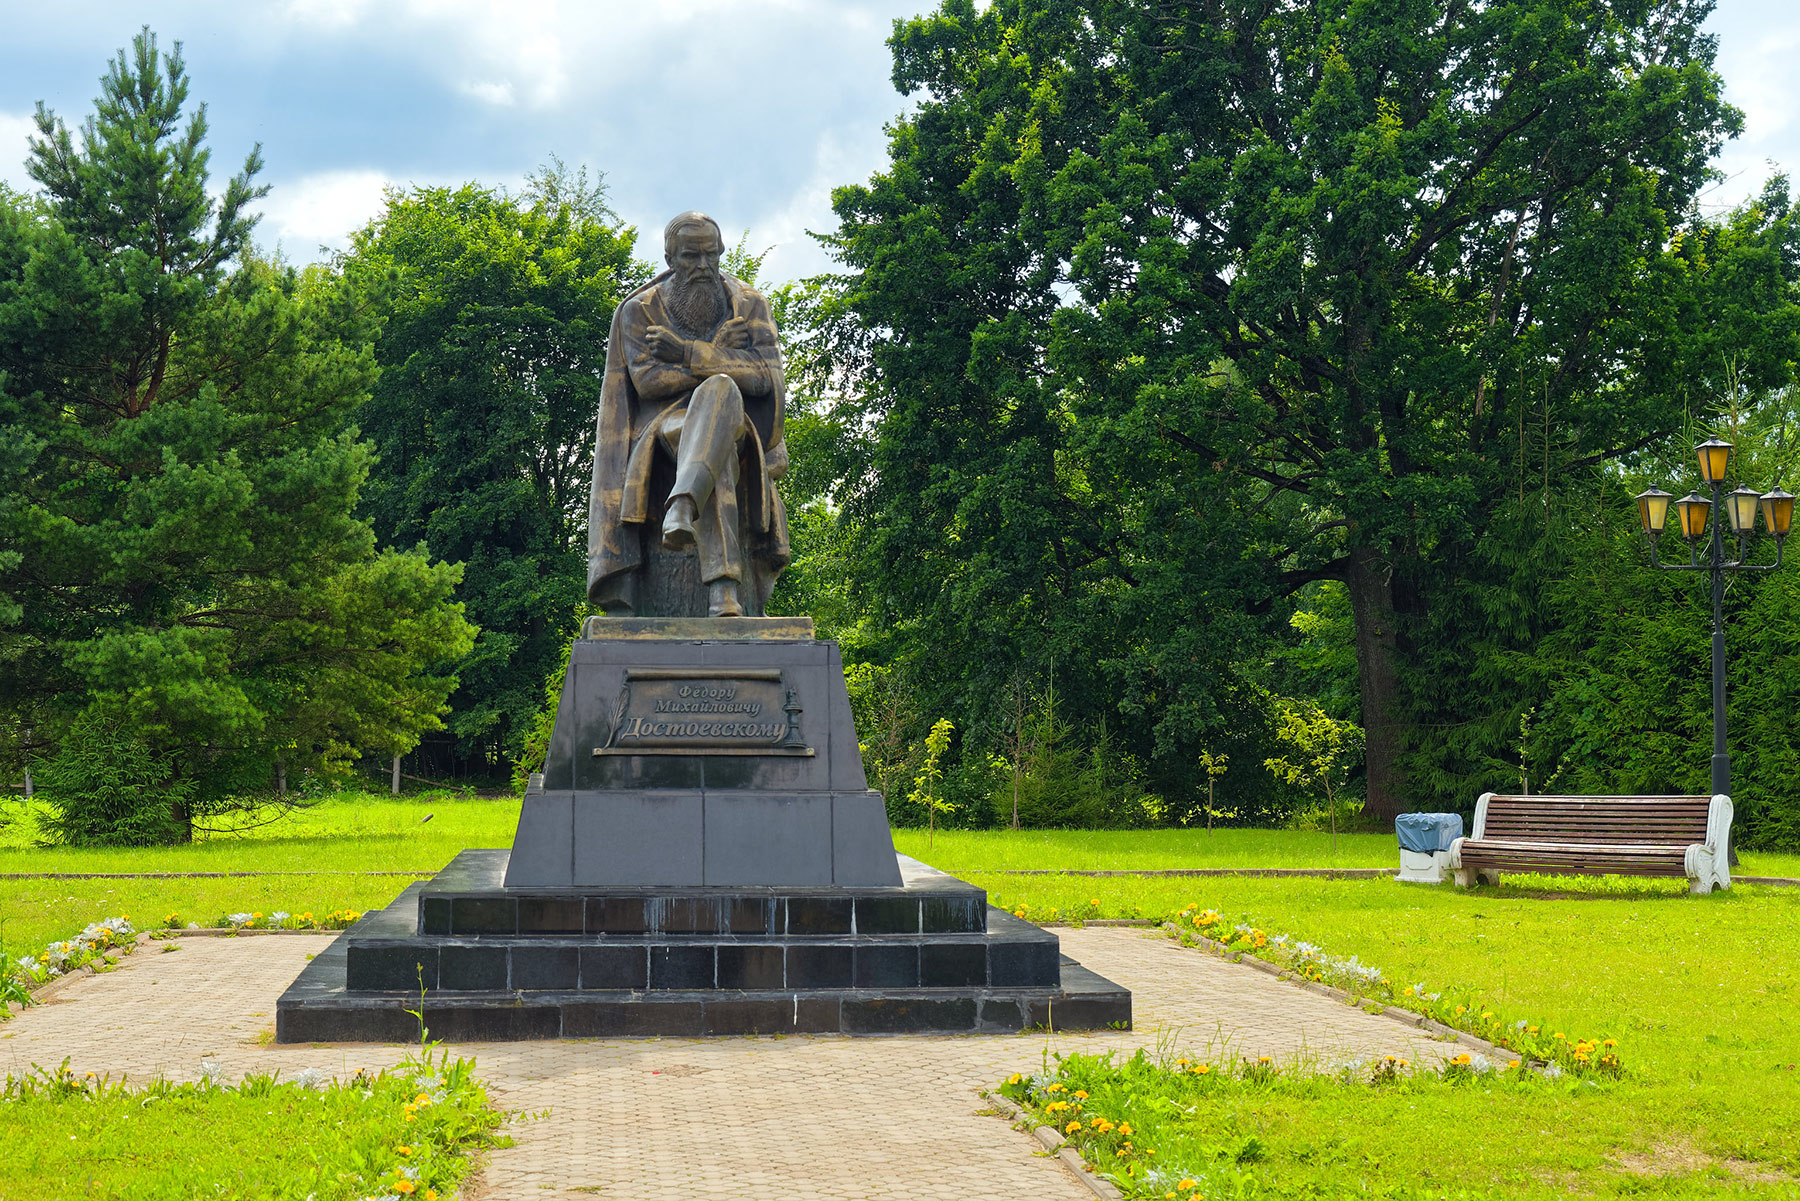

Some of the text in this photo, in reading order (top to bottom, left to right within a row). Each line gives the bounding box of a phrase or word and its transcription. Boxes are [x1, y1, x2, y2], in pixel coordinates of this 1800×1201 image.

[679, 685, 736, 700] Фёдору
[655, 699, 760, 717] Михайловичу
[621, 717, 787, 744] Достоевскому
